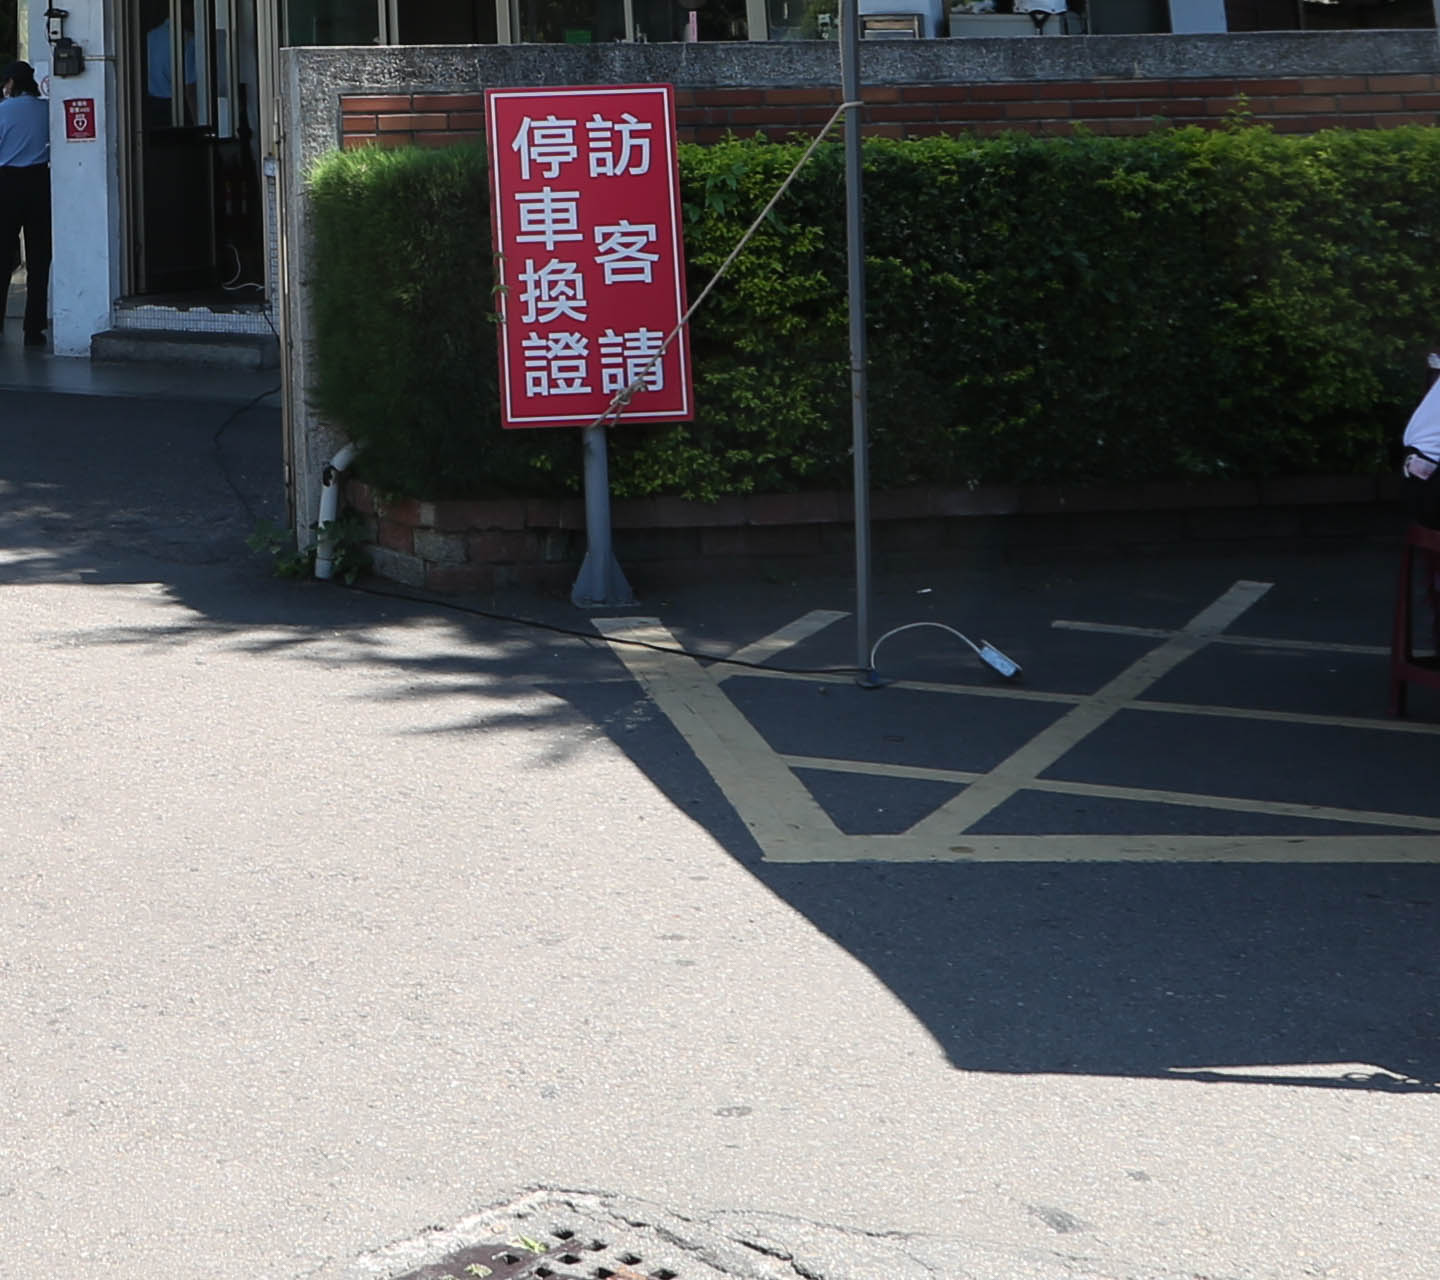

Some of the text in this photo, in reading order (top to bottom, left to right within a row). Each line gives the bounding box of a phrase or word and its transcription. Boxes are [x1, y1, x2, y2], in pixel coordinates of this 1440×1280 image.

[511, 115, 592, 397] 停車換證
[585, 113, 667, 394] 訪客請
